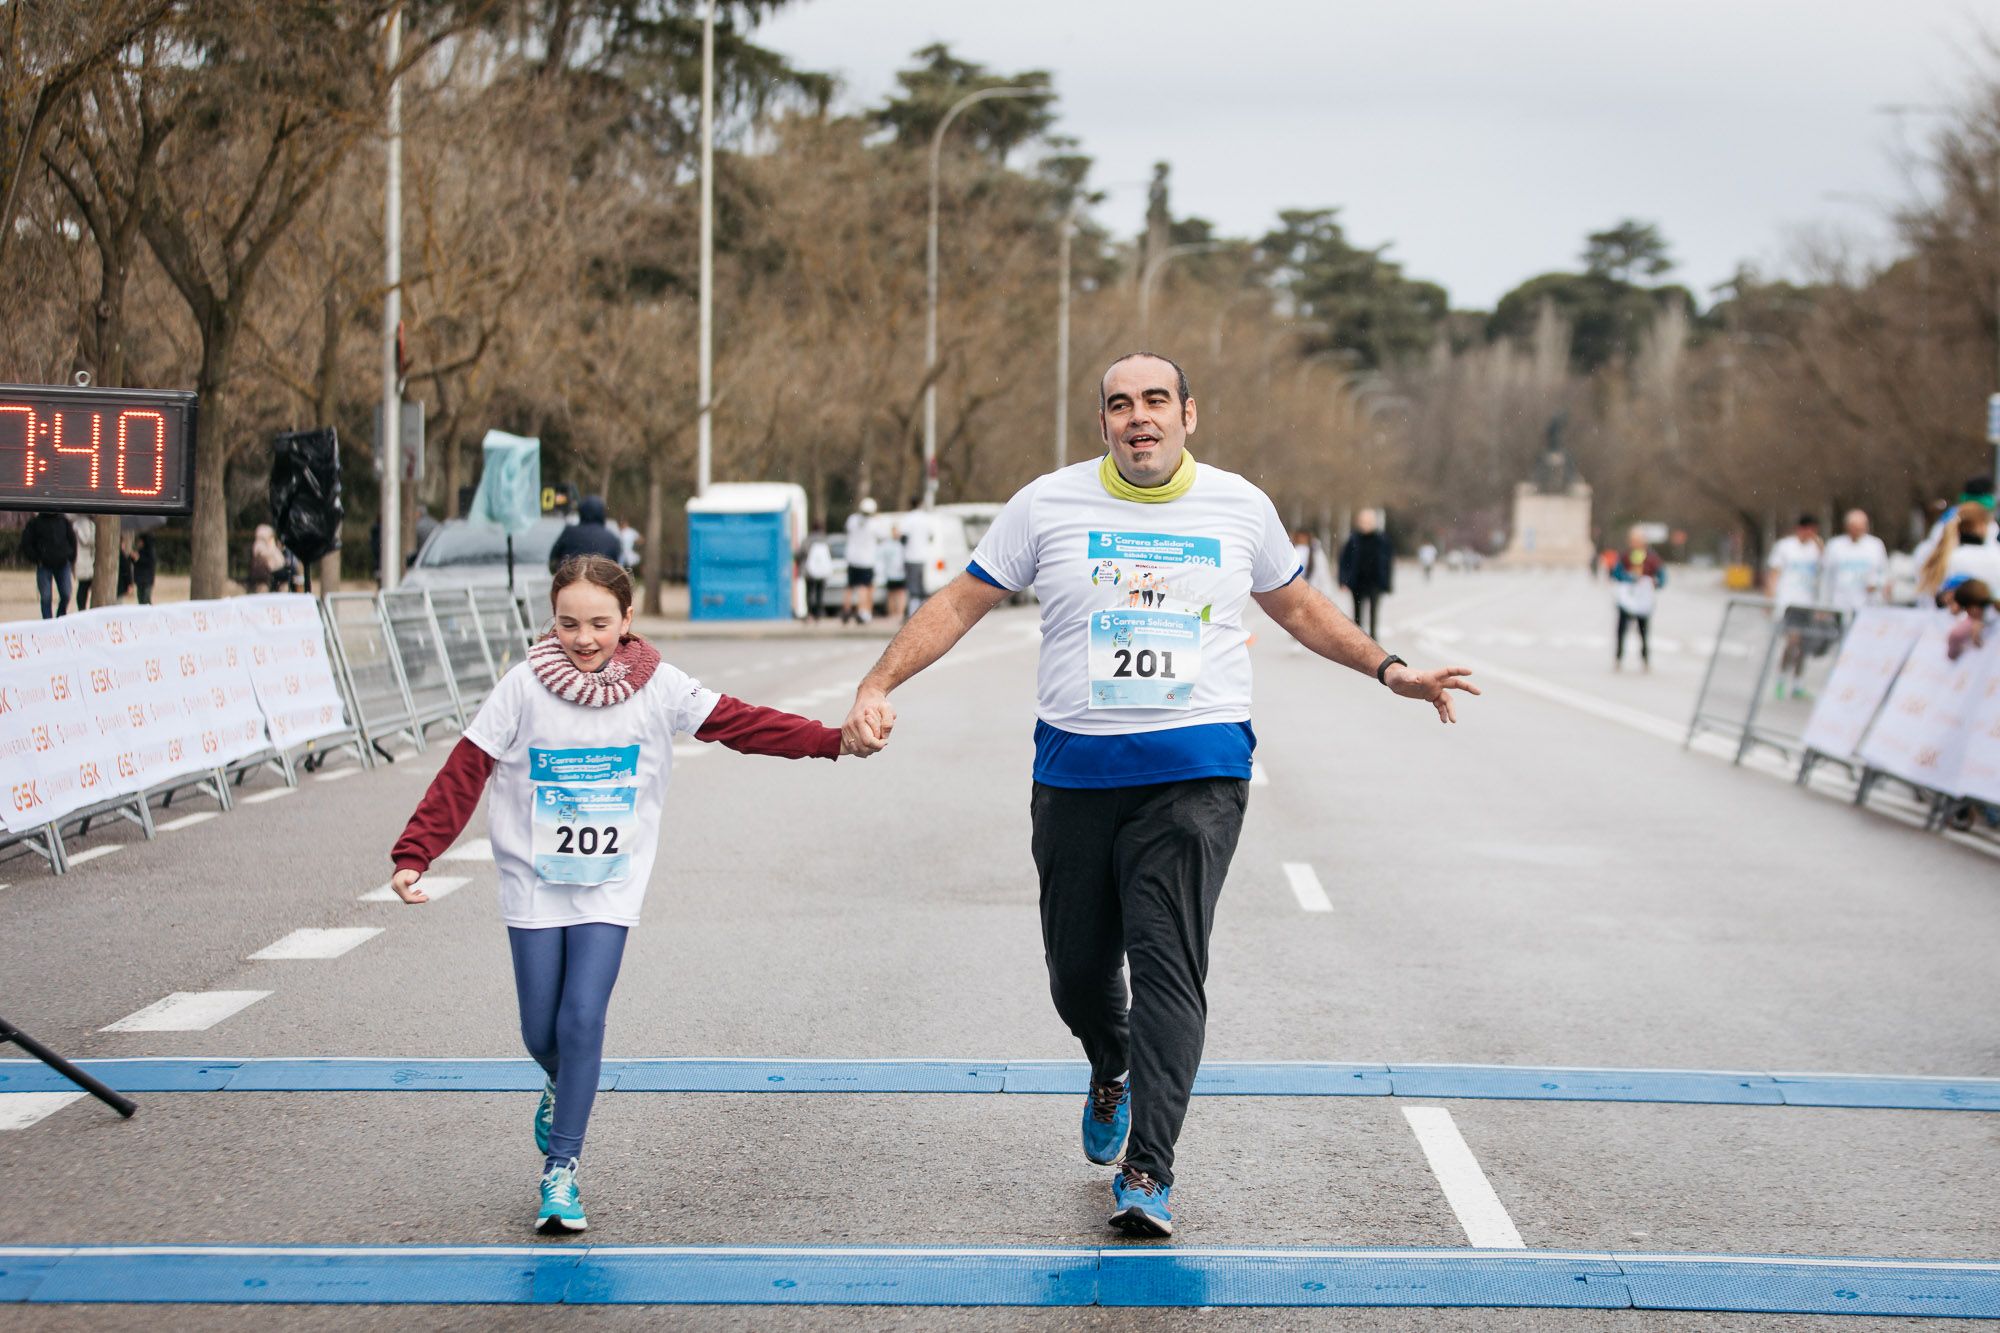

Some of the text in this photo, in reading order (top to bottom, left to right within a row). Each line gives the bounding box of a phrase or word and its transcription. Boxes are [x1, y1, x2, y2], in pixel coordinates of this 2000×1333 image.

[0, 406, 165, 496] 7:40
[1114, 536, 1151, 546] Carrera
[1153, 540, 1194, 548] Solidaria
[1183, 555, 1216, 567] 2026
[1113, 617, 1146, 627] Carrera
[1147, 618, 1184, 629] Solidaria
[4, 633, 29, 660] GSK
[145, 657, 163, 682] GSK
[1113, 649, 1176, 679] 201
[50, 674, 72, 700] GSK
[90, 667, 114, 693] GSK
[31, 723, 55, 752] GSK
[549, 756, 583, 764] Carrera
[585, 754, 622, 763] Solidaria
[80, 762, 101, 788] GSK
[12, 779, 43, 811] GSK
[558, 793, 589, 802] Carrera
[557, 826, 619, 855] 202
